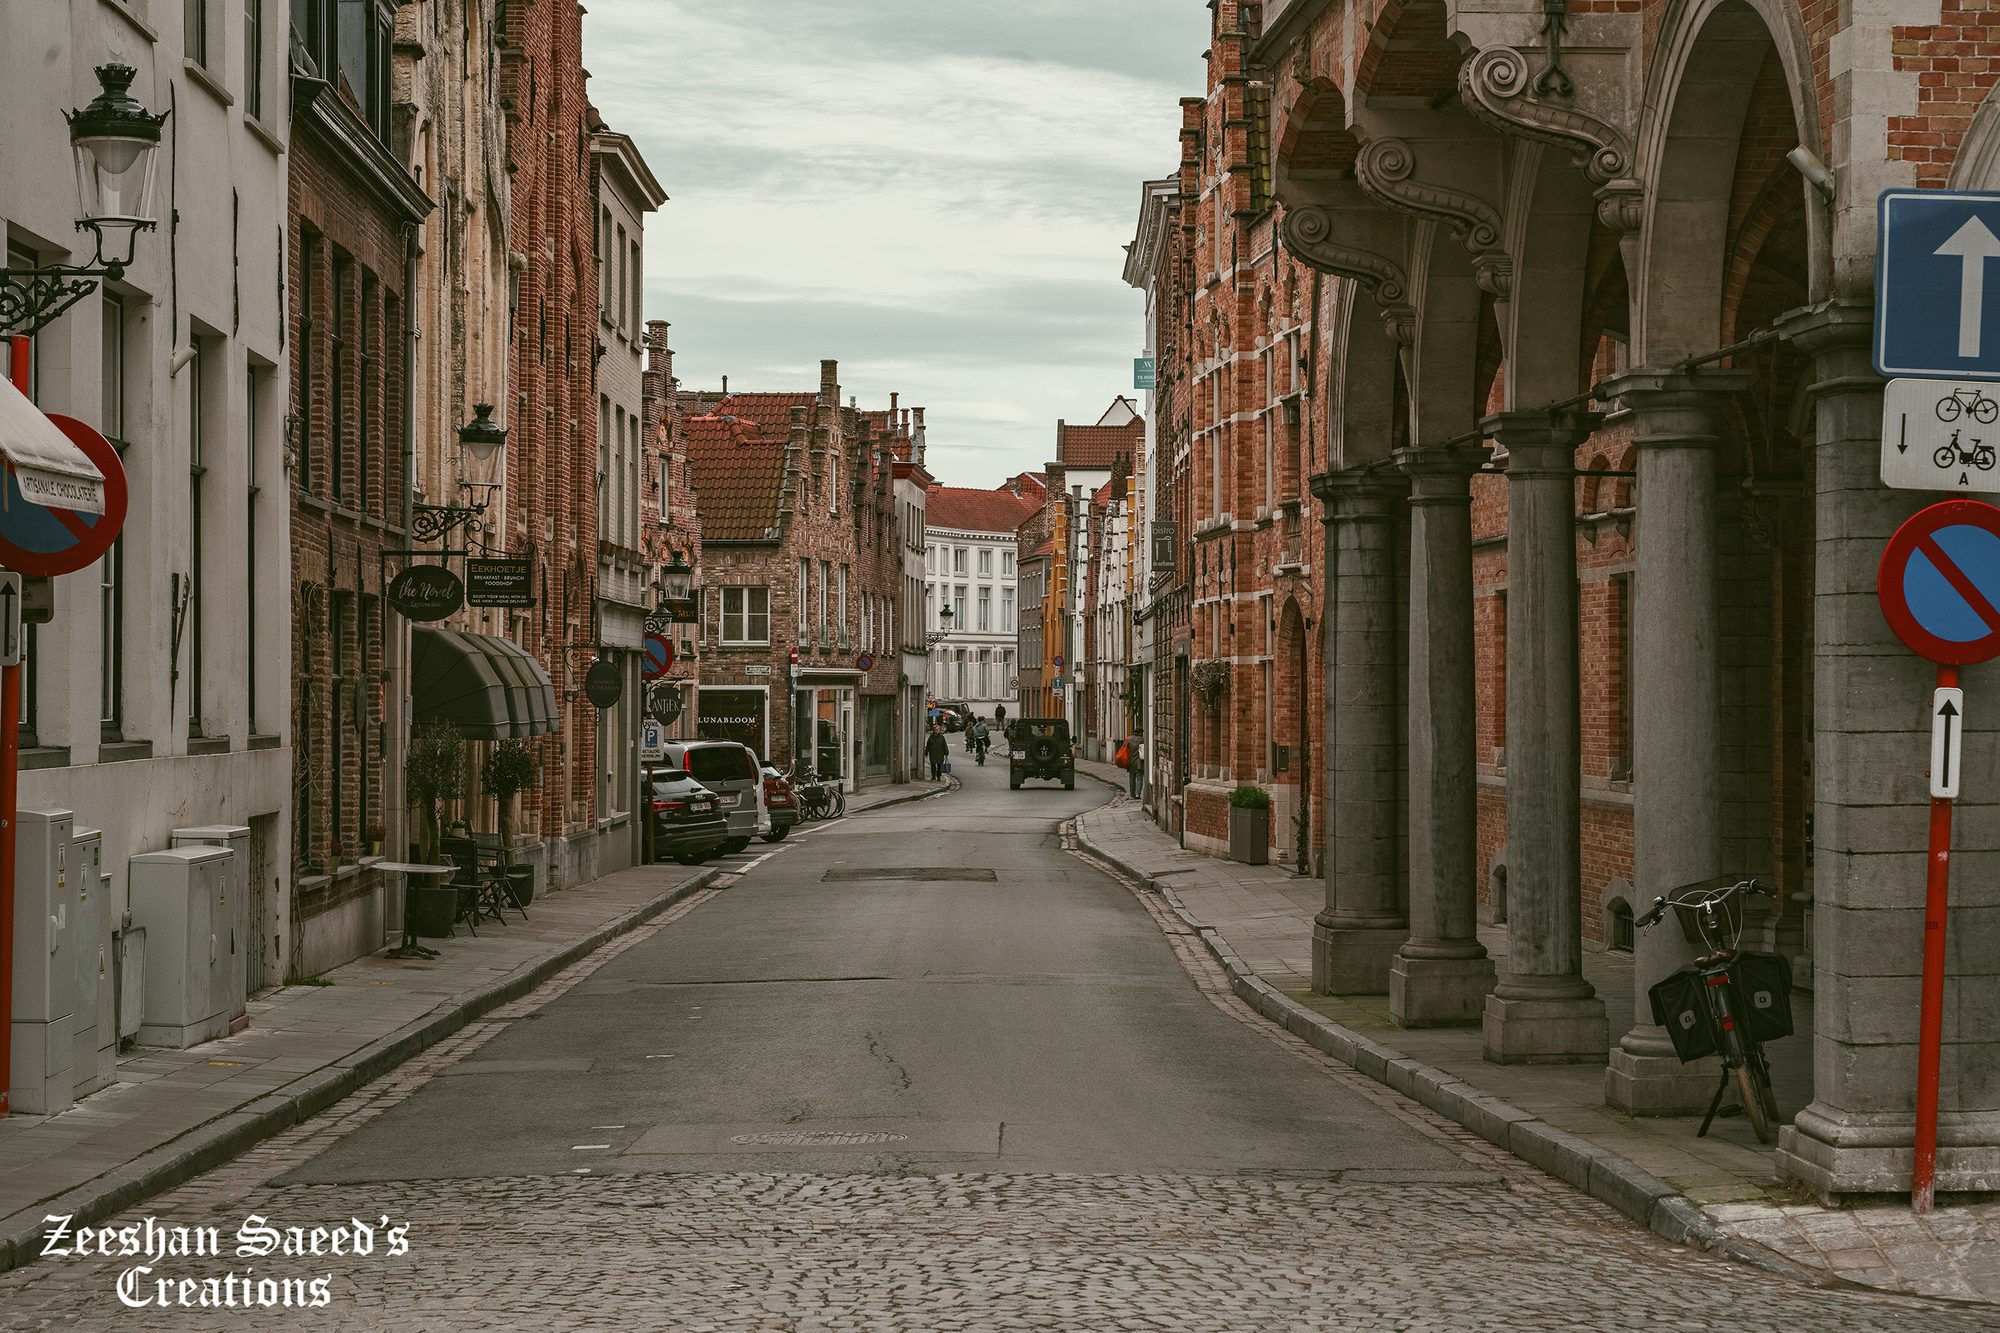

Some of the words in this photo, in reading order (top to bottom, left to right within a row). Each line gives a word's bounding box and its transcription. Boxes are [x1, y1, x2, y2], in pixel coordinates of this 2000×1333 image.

[1959, 472, 1970, 485] A
[23, 476, 57, 496] ARTISANALE
[57, 482, 99, 503] CHOCOLATERIE
[1152, 525, 1175, 535] bistro
[471, 564, 527, 574] EEKHOETJE
[398, 576, 418, 599] the
[420, 580, 455, 601] Novel
[698, 716, 756, 724] LUNABLOOM
[647, 730, 656, 742] P
